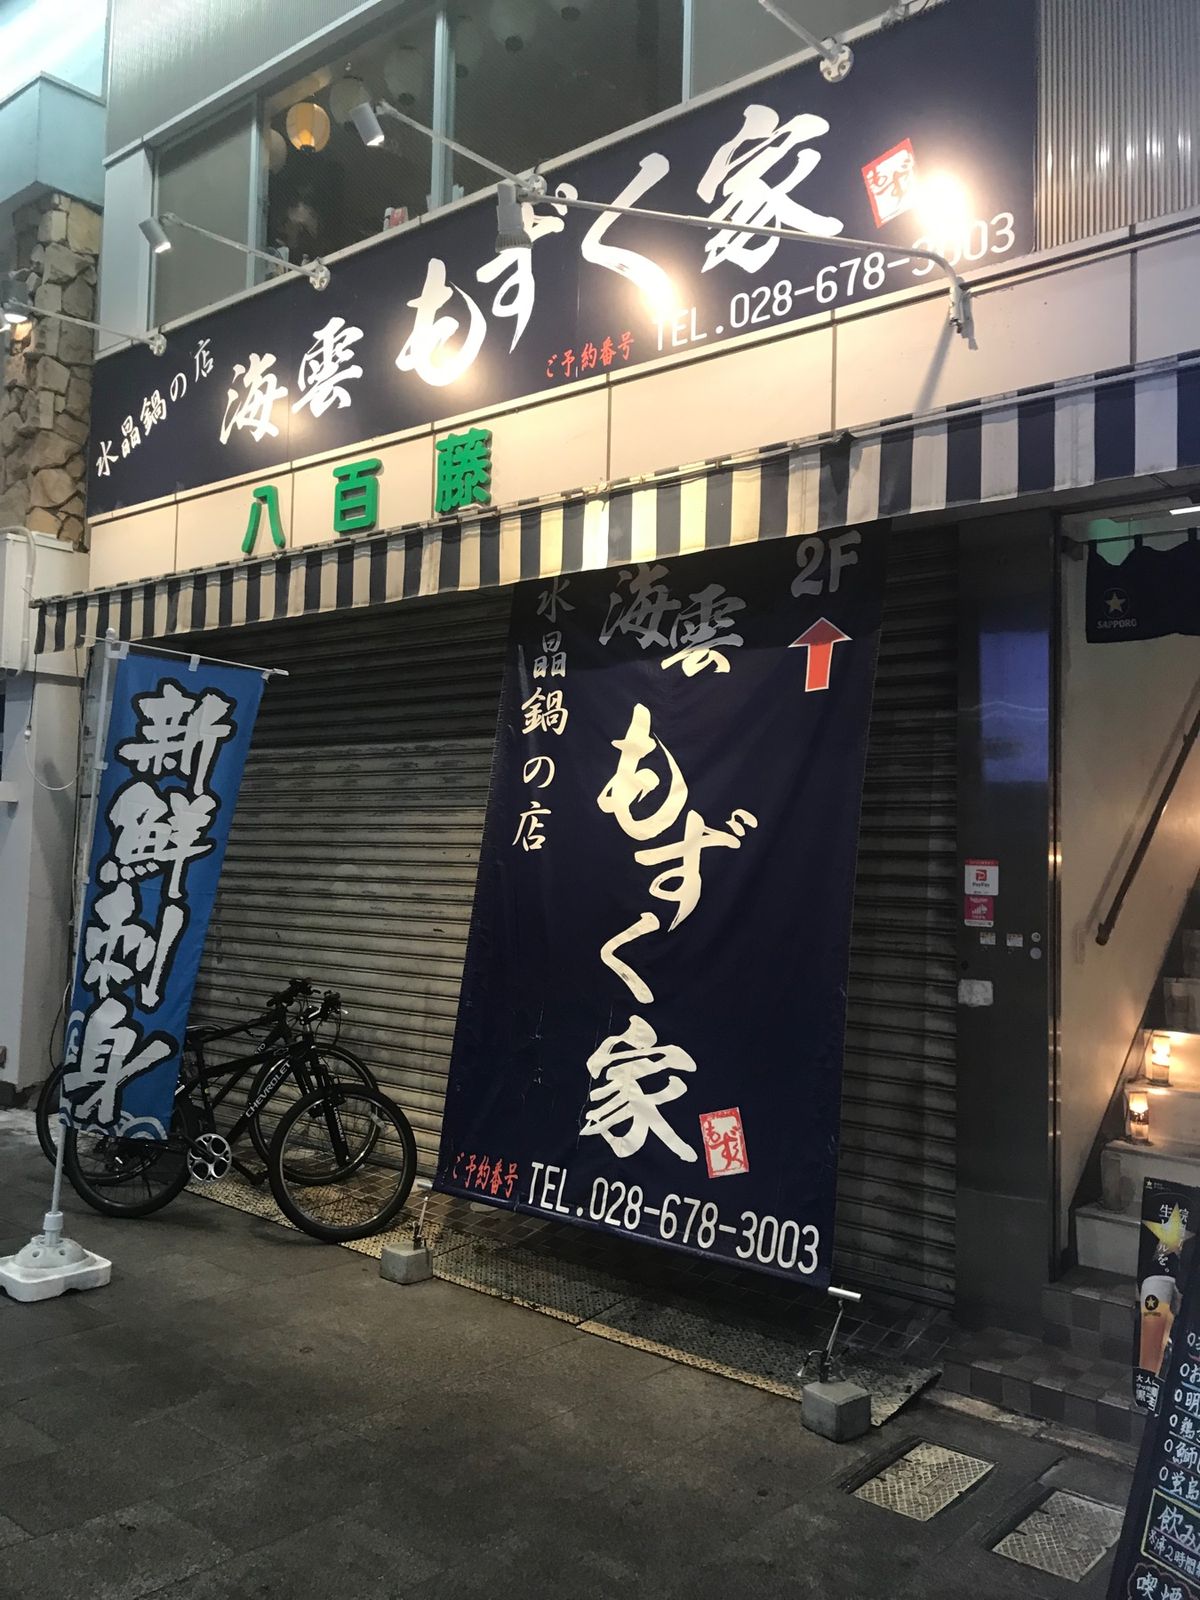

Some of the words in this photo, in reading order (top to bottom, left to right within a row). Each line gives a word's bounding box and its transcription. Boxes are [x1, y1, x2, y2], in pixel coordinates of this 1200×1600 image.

[96, 338, 214, 478] 水晶鍋の店
[219, 316, 364, 445] 海雲
[546, 331, 634, 379] ご予約番号
[241, 428, 493, 554] 八百藤
[791, 530, 861, 598] 2F
[599, 564, 747, 678] 海雲
[1096, 619, 1137, 630] SAPPORO
[512, 577, 576, 852] 水晶鍋の店
[63, 680, 236, 1125] 新鮮刺身
[579, 703, 758, 1163] もずく家
[245, 1061, 291, 1118] CHEVROLET
[452, 1153, 519, 1198] ご予約番号
[528, 1161, 820, 1274] TEL.028-678-3003
[1157, 1504, 1200, 1553] 飲み
